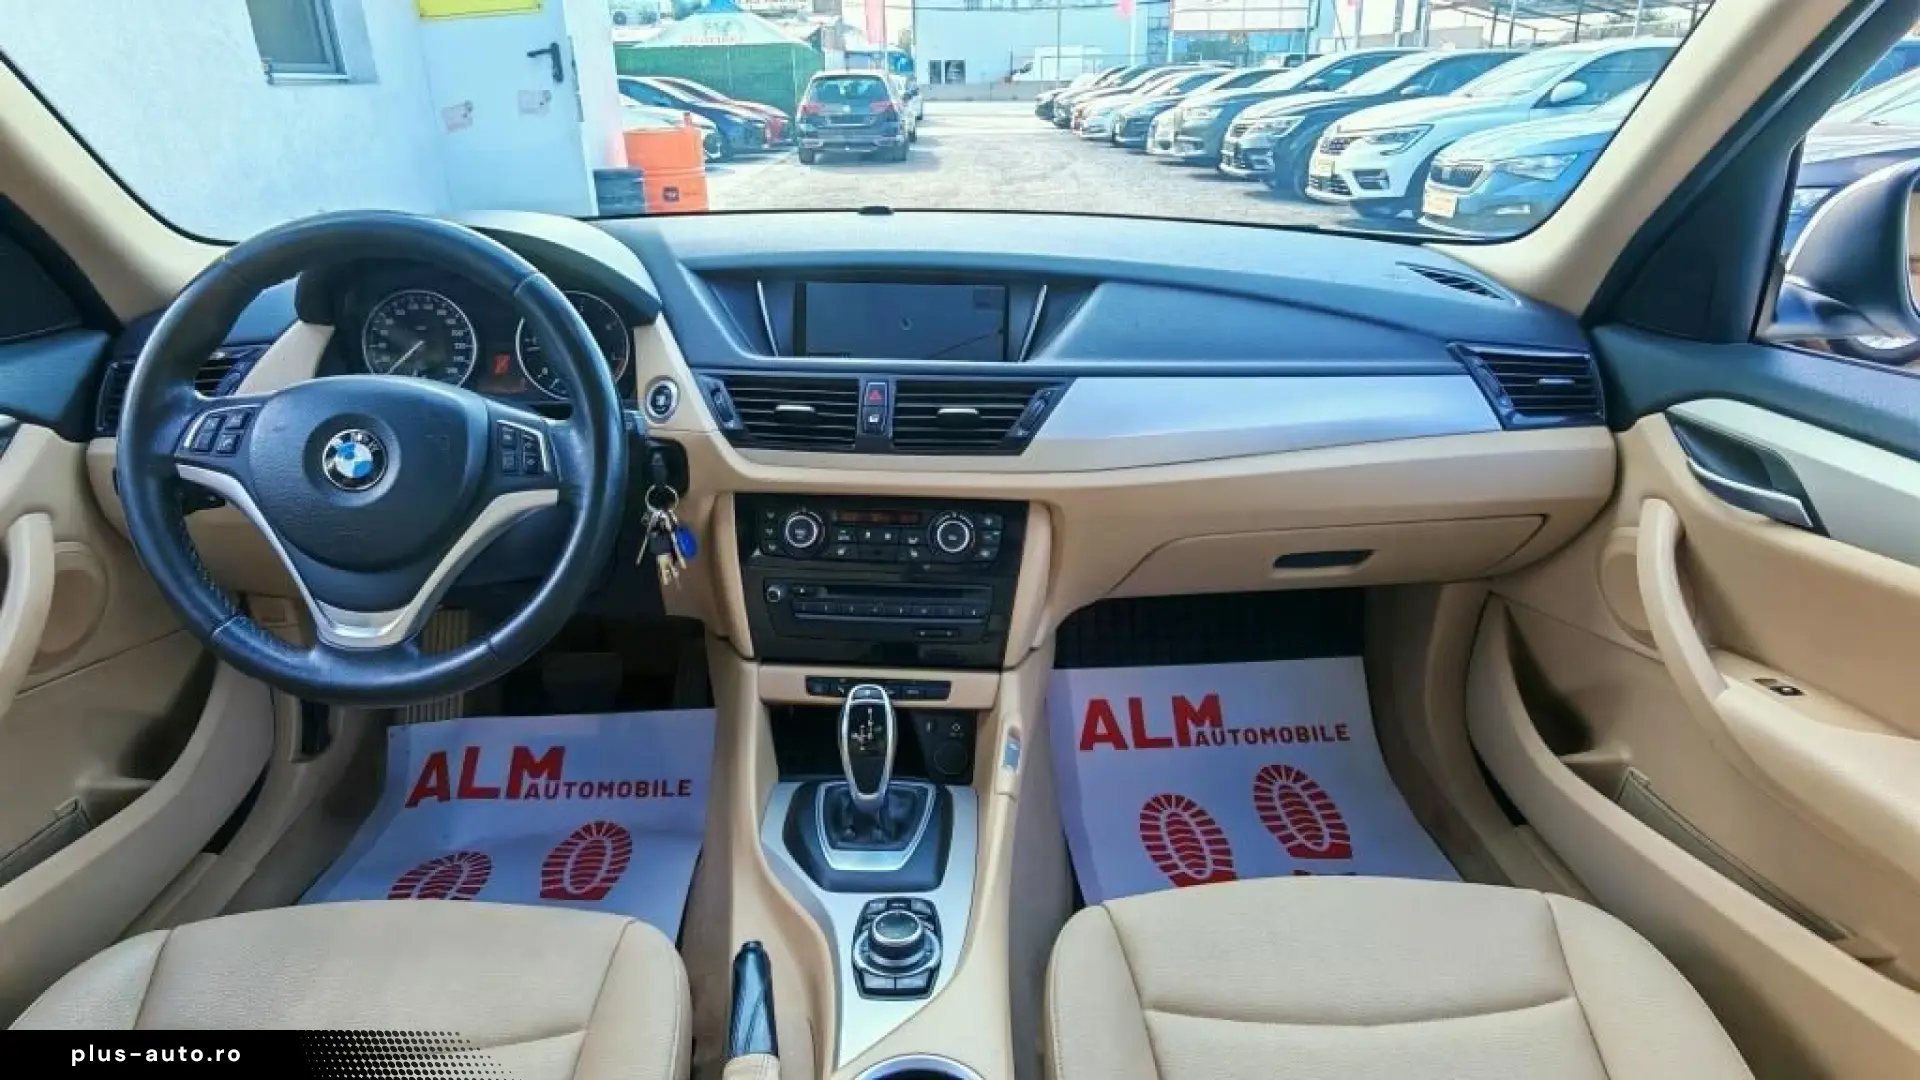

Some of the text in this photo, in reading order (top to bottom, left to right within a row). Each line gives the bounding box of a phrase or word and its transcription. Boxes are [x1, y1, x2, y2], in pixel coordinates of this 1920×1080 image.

[1079, 692, 1223, 751] ALM
[1195, 722, 1351, 748] AUTOMOBILE
[404, 746, 566, 808] ALM
[524, 779, 692, 800] AUTOMOBILE
